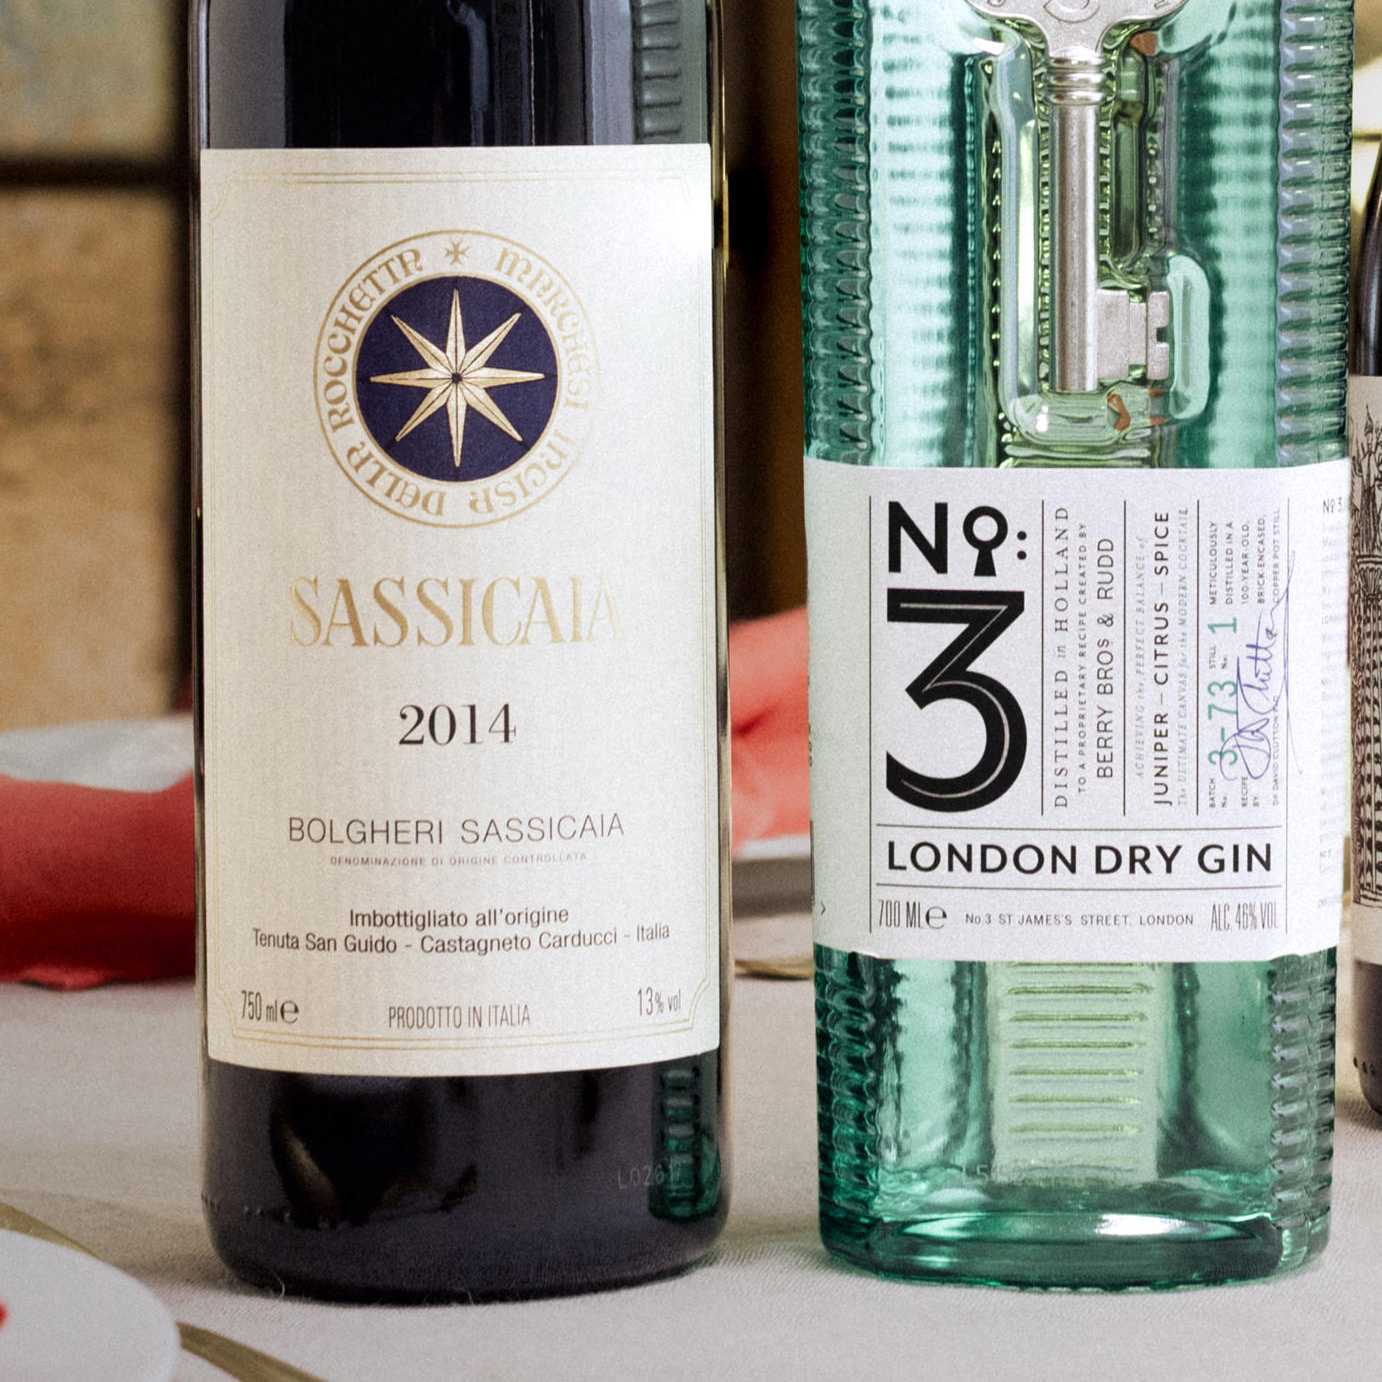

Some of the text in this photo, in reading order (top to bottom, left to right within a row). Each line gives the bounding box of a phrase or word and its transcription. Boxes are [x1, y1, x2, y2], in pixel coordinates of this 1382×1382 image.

[1079, 523, 1087, 538] BY
[1079, 545, 1087, 605] CREATED
[1097, 538, 1114, 600] RUDD
[1209, 521, 1217, 605] METICULOUSLY
[1225, 521, 1233, 605] DISTILLED IN A
[1136, 555, 1145, 614] BALANCE
[290, 574, 625, 648] SASSICAIA
[1097, 613, 1114, 627] &
[1208, 617, 1237, 634] 1
[1079, 612, 1087, 657] RECIPE
[1136, 621, 1145, 676] PERFECT
[1053, 508, 1069, 809] DISTILLED in HOLLAND
[1154, 513, 1173, 806] JUNIPER CITRUS SPICE
[886, 588, 1028, 813] 3
[1079, 665, 1087, 756] PROPRIETARY
[1178, 673, 1187, 719] CANVAS
[399, 702, 517, 747] 2014
[1097, 705, 1113, 778] BERRY
[1135, 706, 1145, 779] ACHIEVING
[1079, 777, 1087, 793] TO
[1253, 796, 1259, 807] BY
[289, 812, 625, 845] BOLGHERI SASSICAIA
[330, 852, 588, 867] DENOMINAZIONE DI ORIGINE CONTROLLATA
[887, 841, 1272, 876] LONDON DRY GIN
[349, 906, 569, 931] Imbottigliato all'origine
[879, 899, 901, 928] 700
[999, 913, 1013, 925] ST
[1139, 914, 1194, 926] LONDON
[1260, 901, 1279, 929] VOL
[252, 924, 670, 956] Tenuta San Guido Castagneto Carducci Italia
[240, 990, 263, 1020] 750
[388, 1004, 531, 1029] PRODOTTO IN ITALIA
[637, 987, 681, 1016] 13% vol
